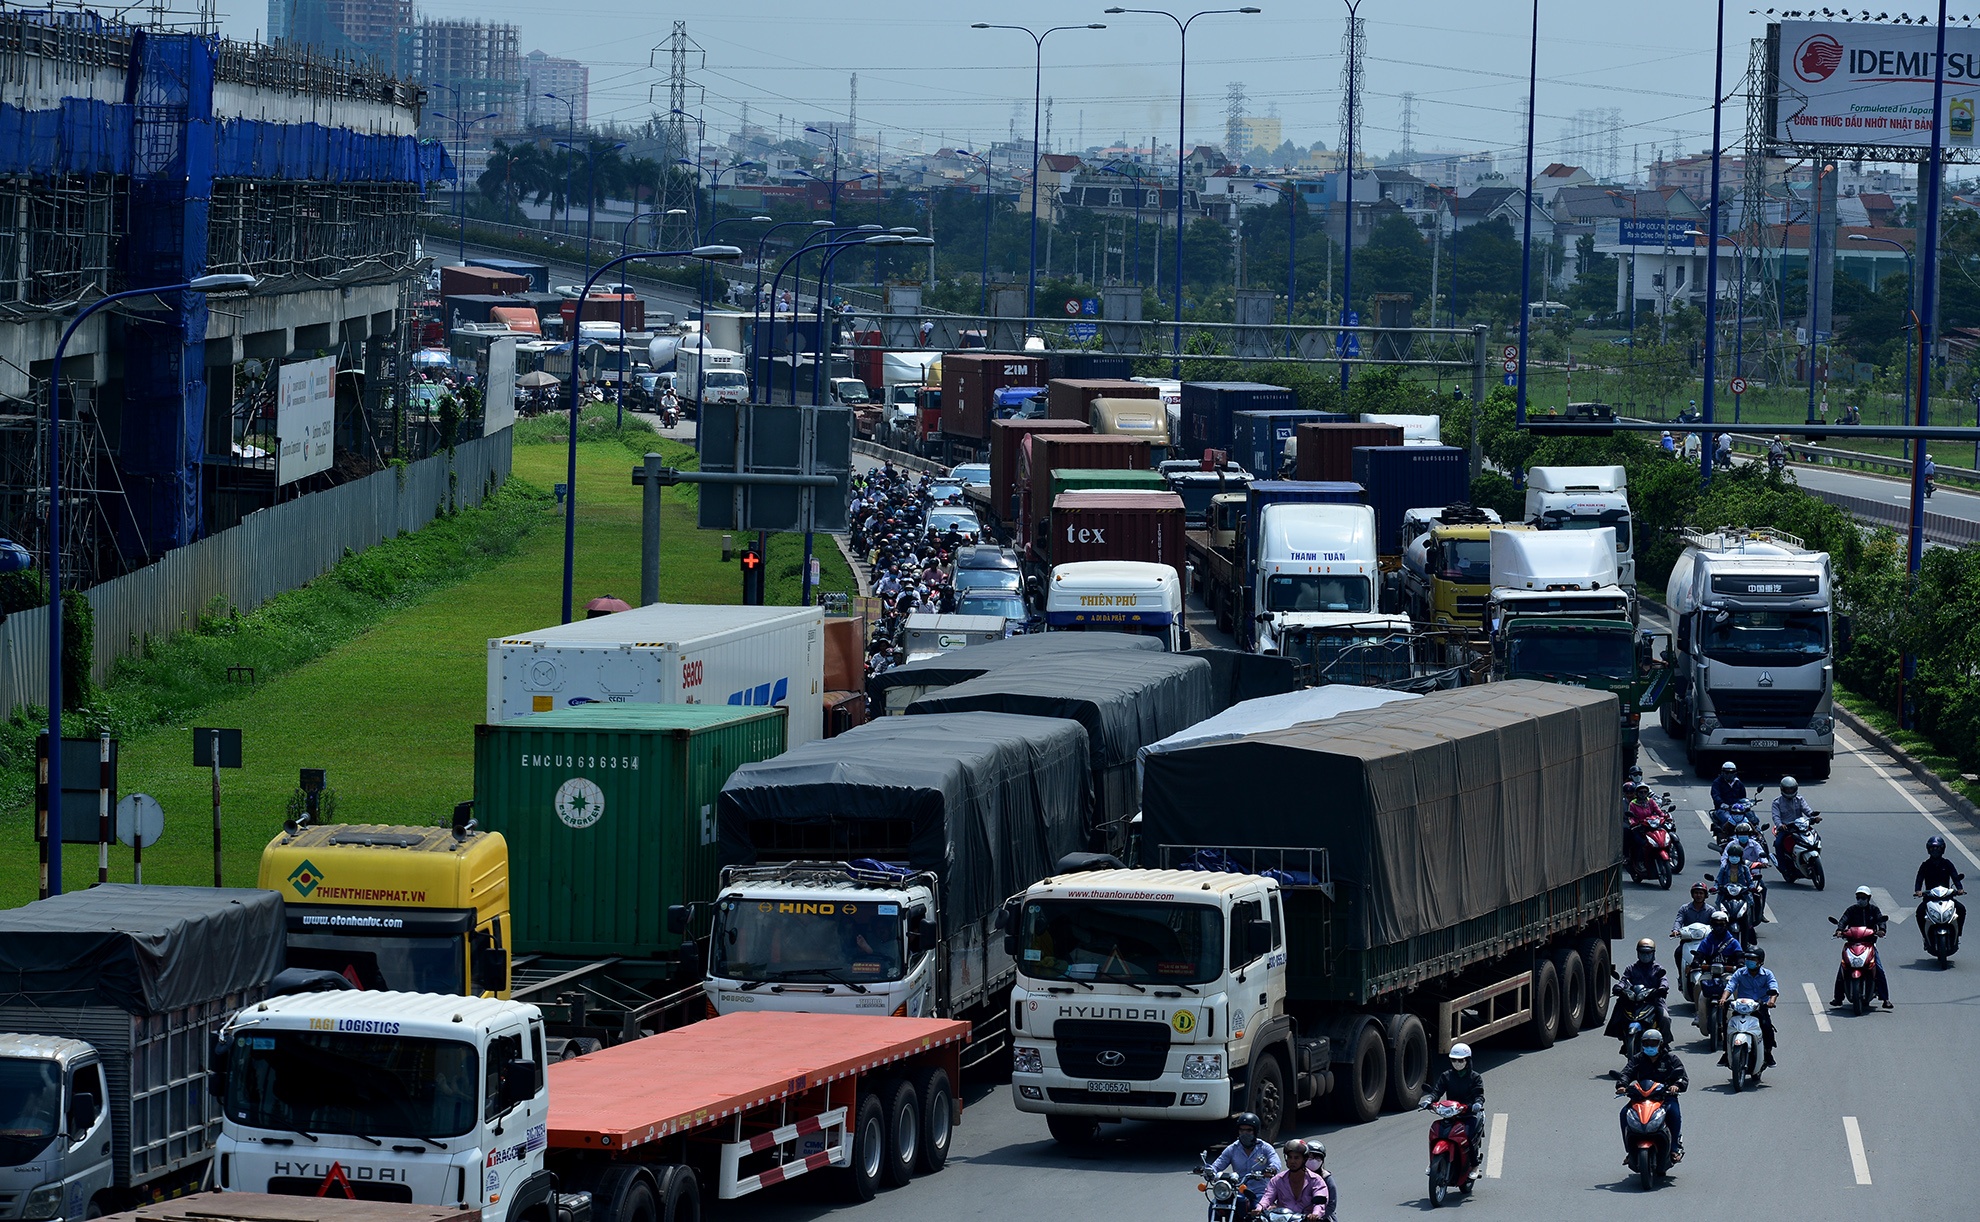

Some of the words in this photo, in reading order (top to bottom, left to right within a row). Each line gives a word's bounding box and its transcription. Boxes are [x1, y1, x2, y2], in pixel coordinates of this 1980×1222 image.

[1850, 103, 1898, 114] Formulated
[1899, 105, 1907, 113] in
[1908, 105, 1934, 116] Japan
[1003, 364, 1028, 376] ZIM
[1066, 523, 1106, 544] tex
[1290, 552, 1317, 561] THANH
[1080, 592, 1113, 606] THIÊN
[1115, 593, 1137, 606] PHÚ
[682, 659, 703, 689] seaco
[521, 754, 640, 771] EMCU3636354
[558, 804, 602, 826] EVERGREEN
[316, 886, 426, 903] THIENTHIENPHAT.VN
[778, 902, 836, 915] HINO
[1059, 1005, 1166, 1021] HYUNDAI
[309, 1017, 335, 1031] TAGI
[338, 1018, 400, 1035] LOGISTICS
[274, 1160, 406, 1182] HYUNDAI
